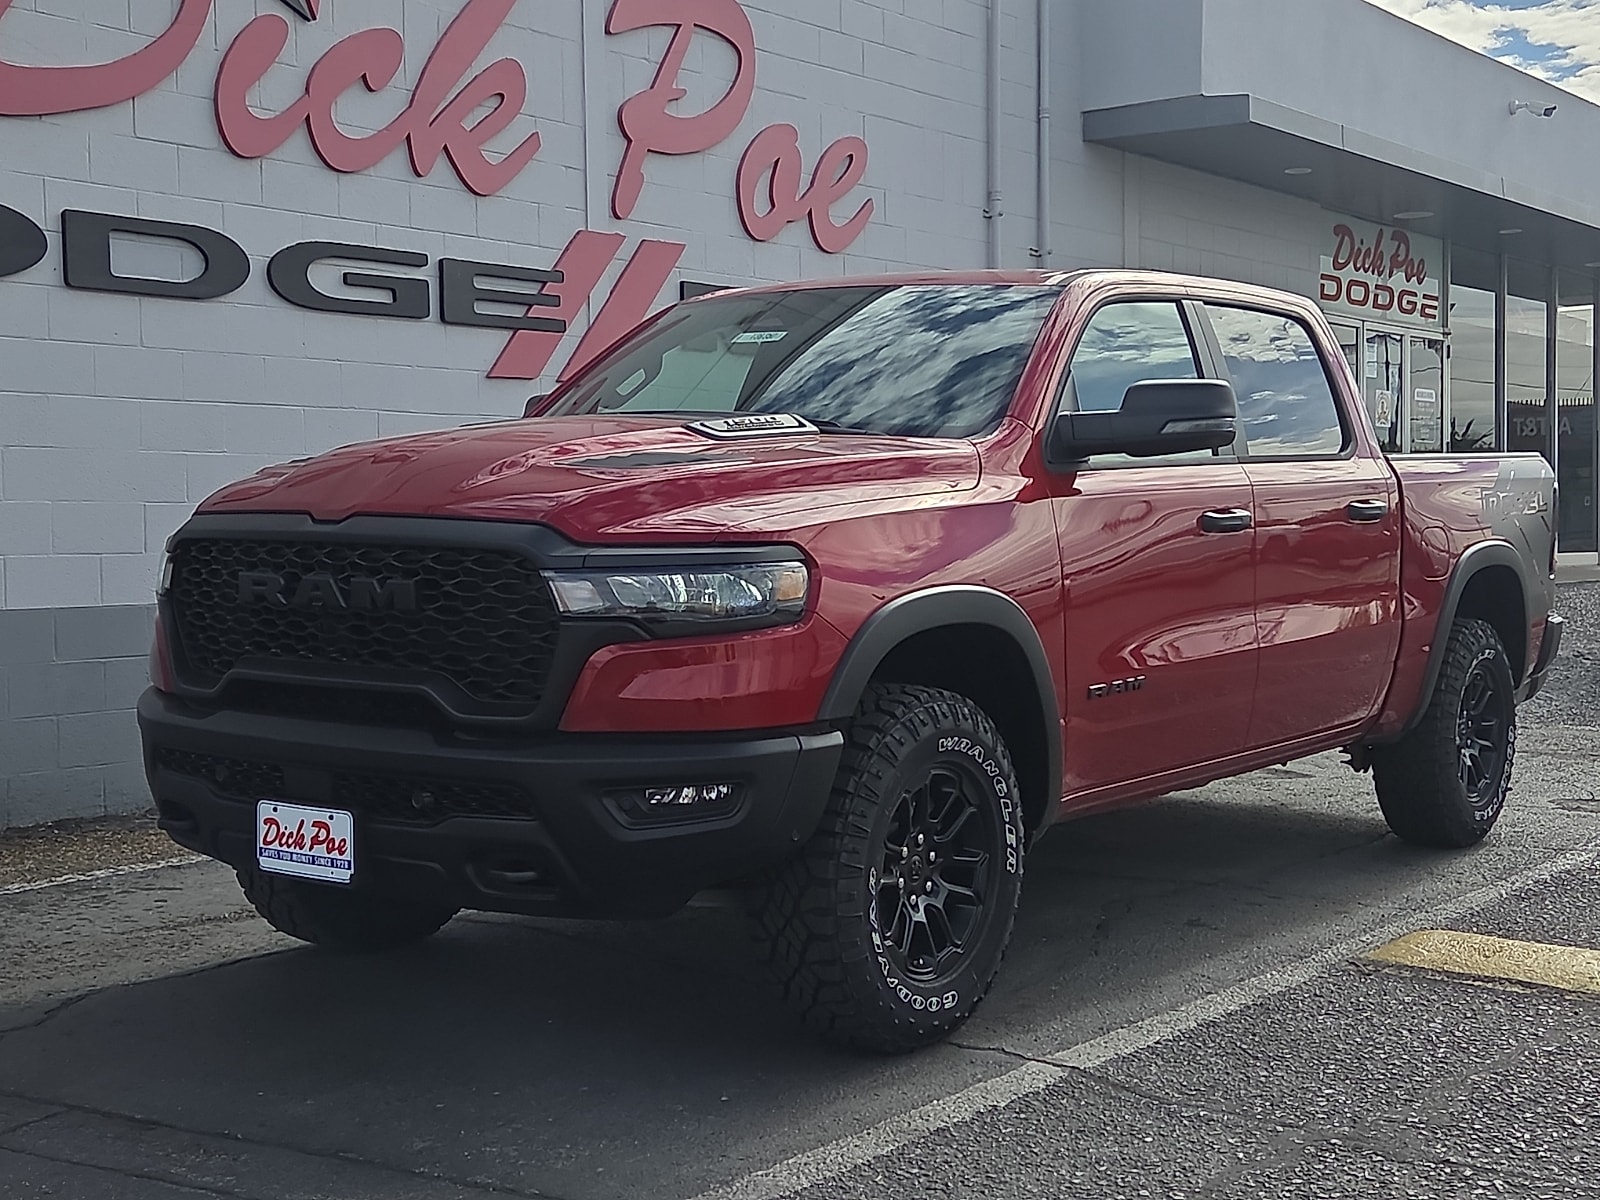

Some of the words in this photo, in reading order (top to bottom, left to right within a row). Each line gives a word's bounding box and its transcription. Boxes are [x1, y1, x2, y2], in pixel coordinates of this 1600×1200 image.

[605, 0, 874, 254] Poe
[0, 203, 566, 332] DGE
[1332, 223, 1386, 278] Dick
[1388, 229, 1427, 286] Poe
[1319, 272, 1439, 320] DODGE
[238, 571, 416, 610] RAM
[1087, 675, 1147, 700] RAM
[938, 736, 1017, 875] WRANGLER
[261, 848, 278, 859] SAVES
[279, 851, 291, 861] YOU
[292, 853, 313, 864] MONEY
[314, 856, 332, 866] SINCE
[262, 817, 307, 851] Dick
[309, 820, 348, 857] Poe
[868, 866, 959, 1012] GOODYEAR
